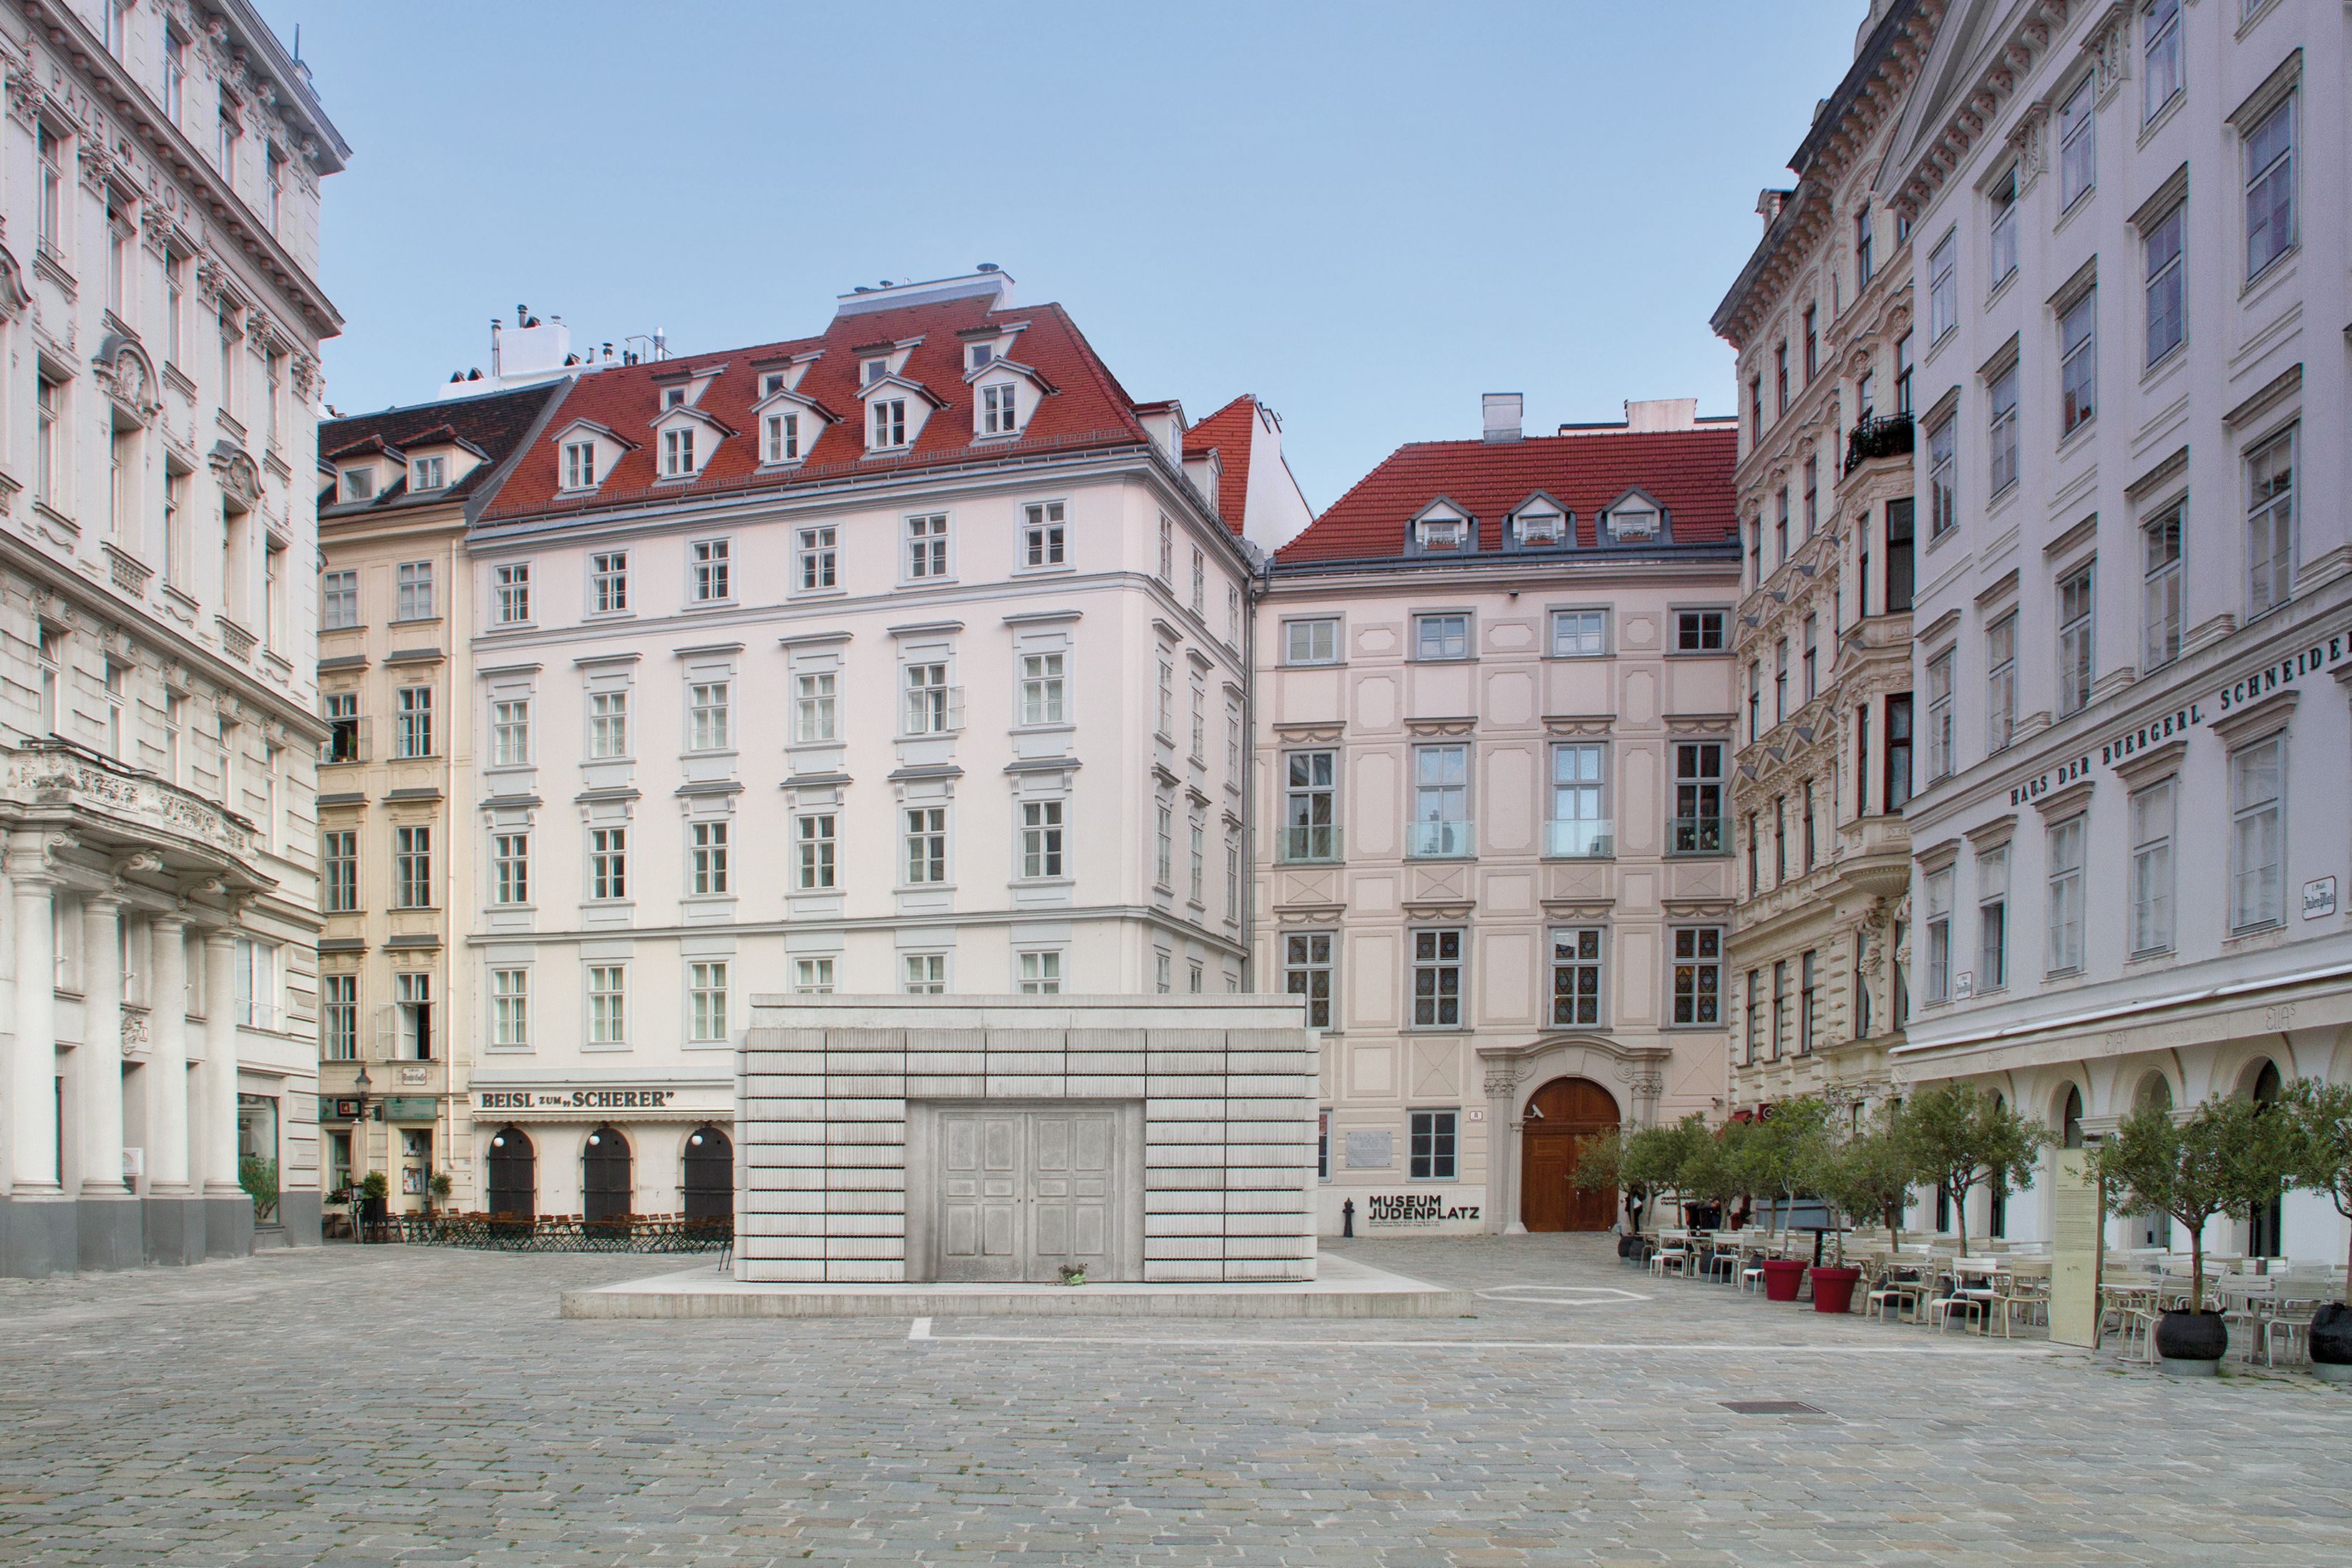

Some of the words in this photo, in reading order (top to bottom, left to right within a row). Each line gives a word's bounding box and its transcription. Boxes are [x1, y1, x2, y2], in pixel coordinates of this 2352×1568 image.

[2010, 775, 2048, 807] HAUS
[2057, 756, 2089, 784] DER
[482, 1093, 535, 1108] BEISL
[1370, 1195, 1442, 1207] MUSEUM
[1369, 1207, 1479, 1219] JUDENPLATZ
